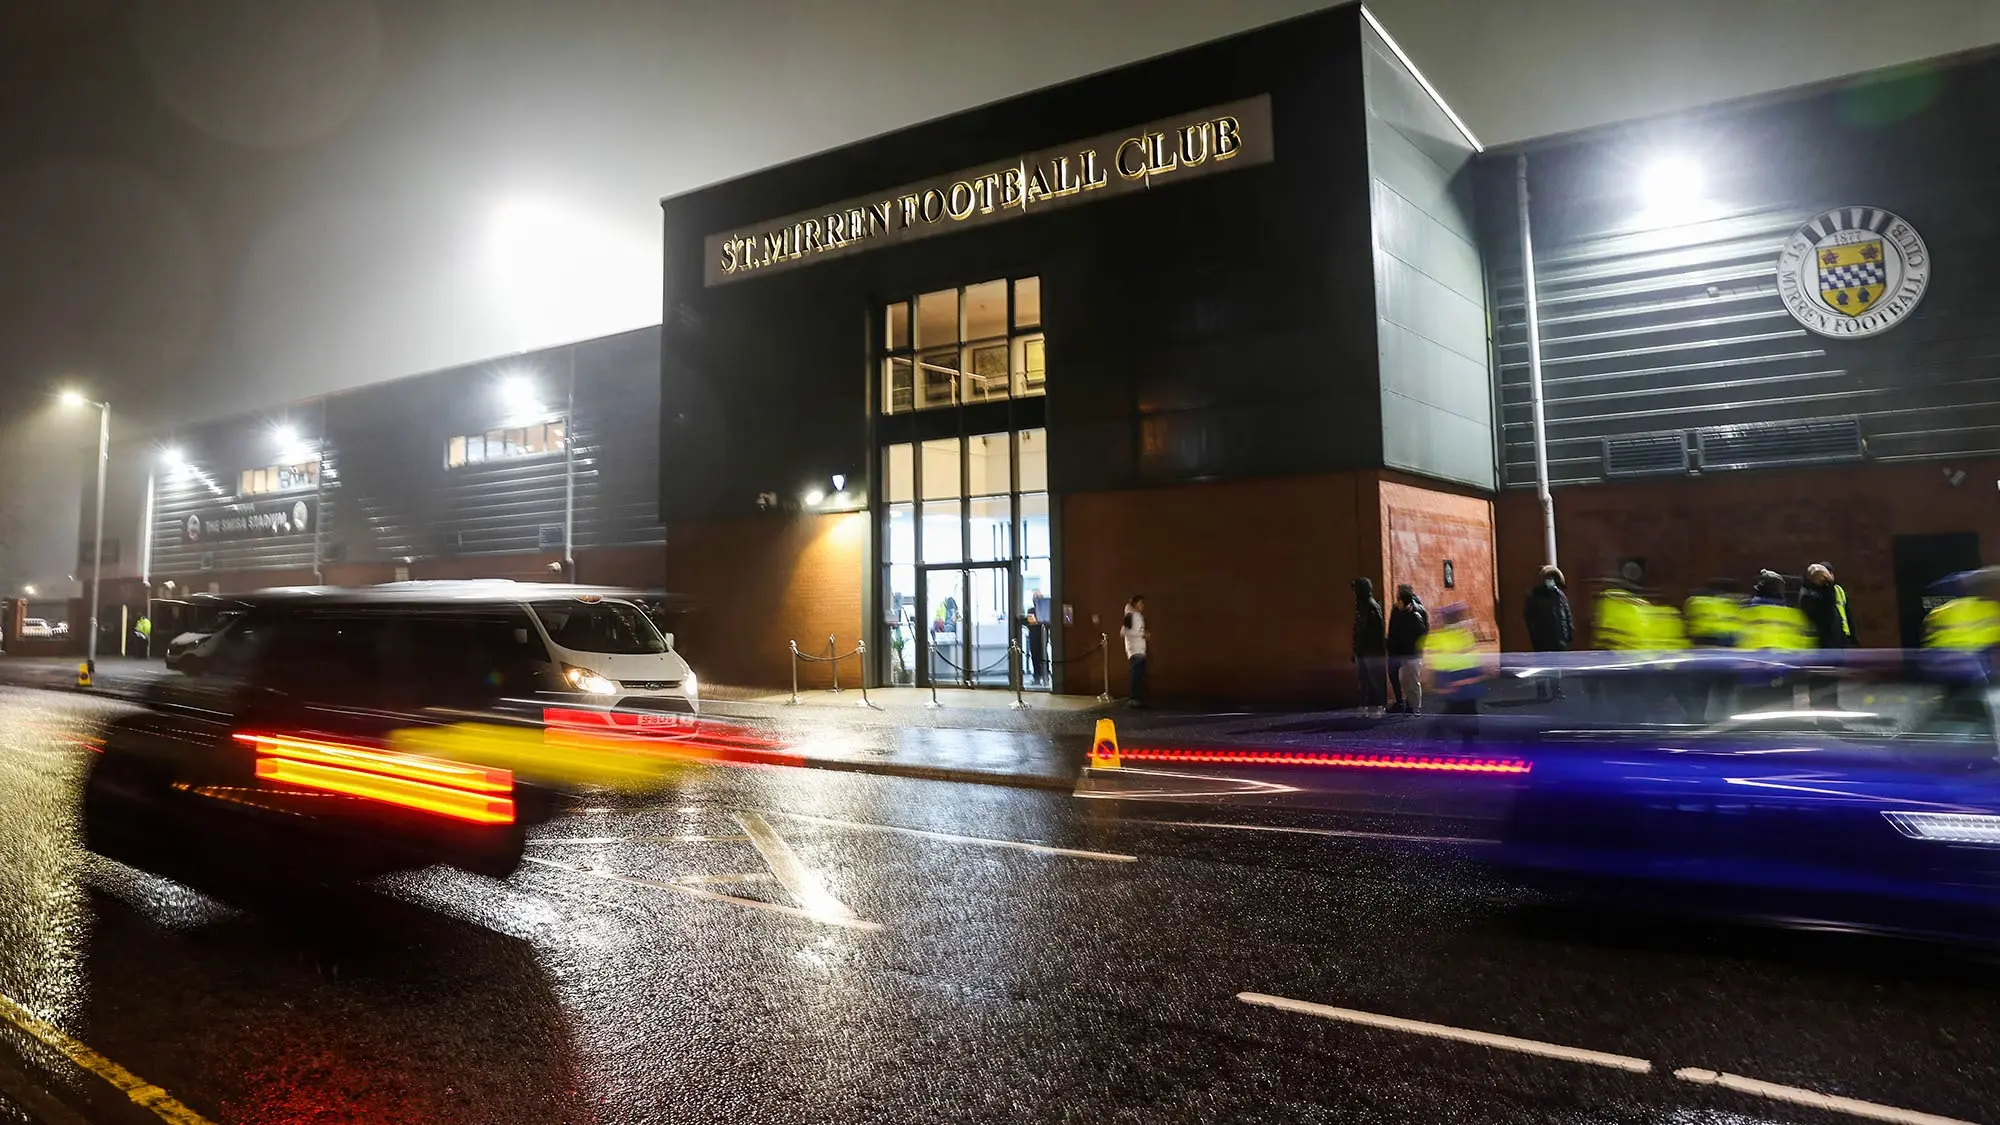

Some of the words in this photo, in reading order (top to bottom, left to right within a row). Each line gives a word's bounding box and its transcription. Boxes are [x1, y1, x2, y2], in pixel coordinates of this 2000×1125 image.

[898, 149, 1108, 230] FOOTBALL
[1114, 115, 1242, 180] CLUB
[1781, 269, 1830, 329] MIRREN
[1834, 273, 1924, 333] FOOTBALL
[1891, 224, 1925, 268] CLUB
[248, 511, 287, 529] STADIUM
